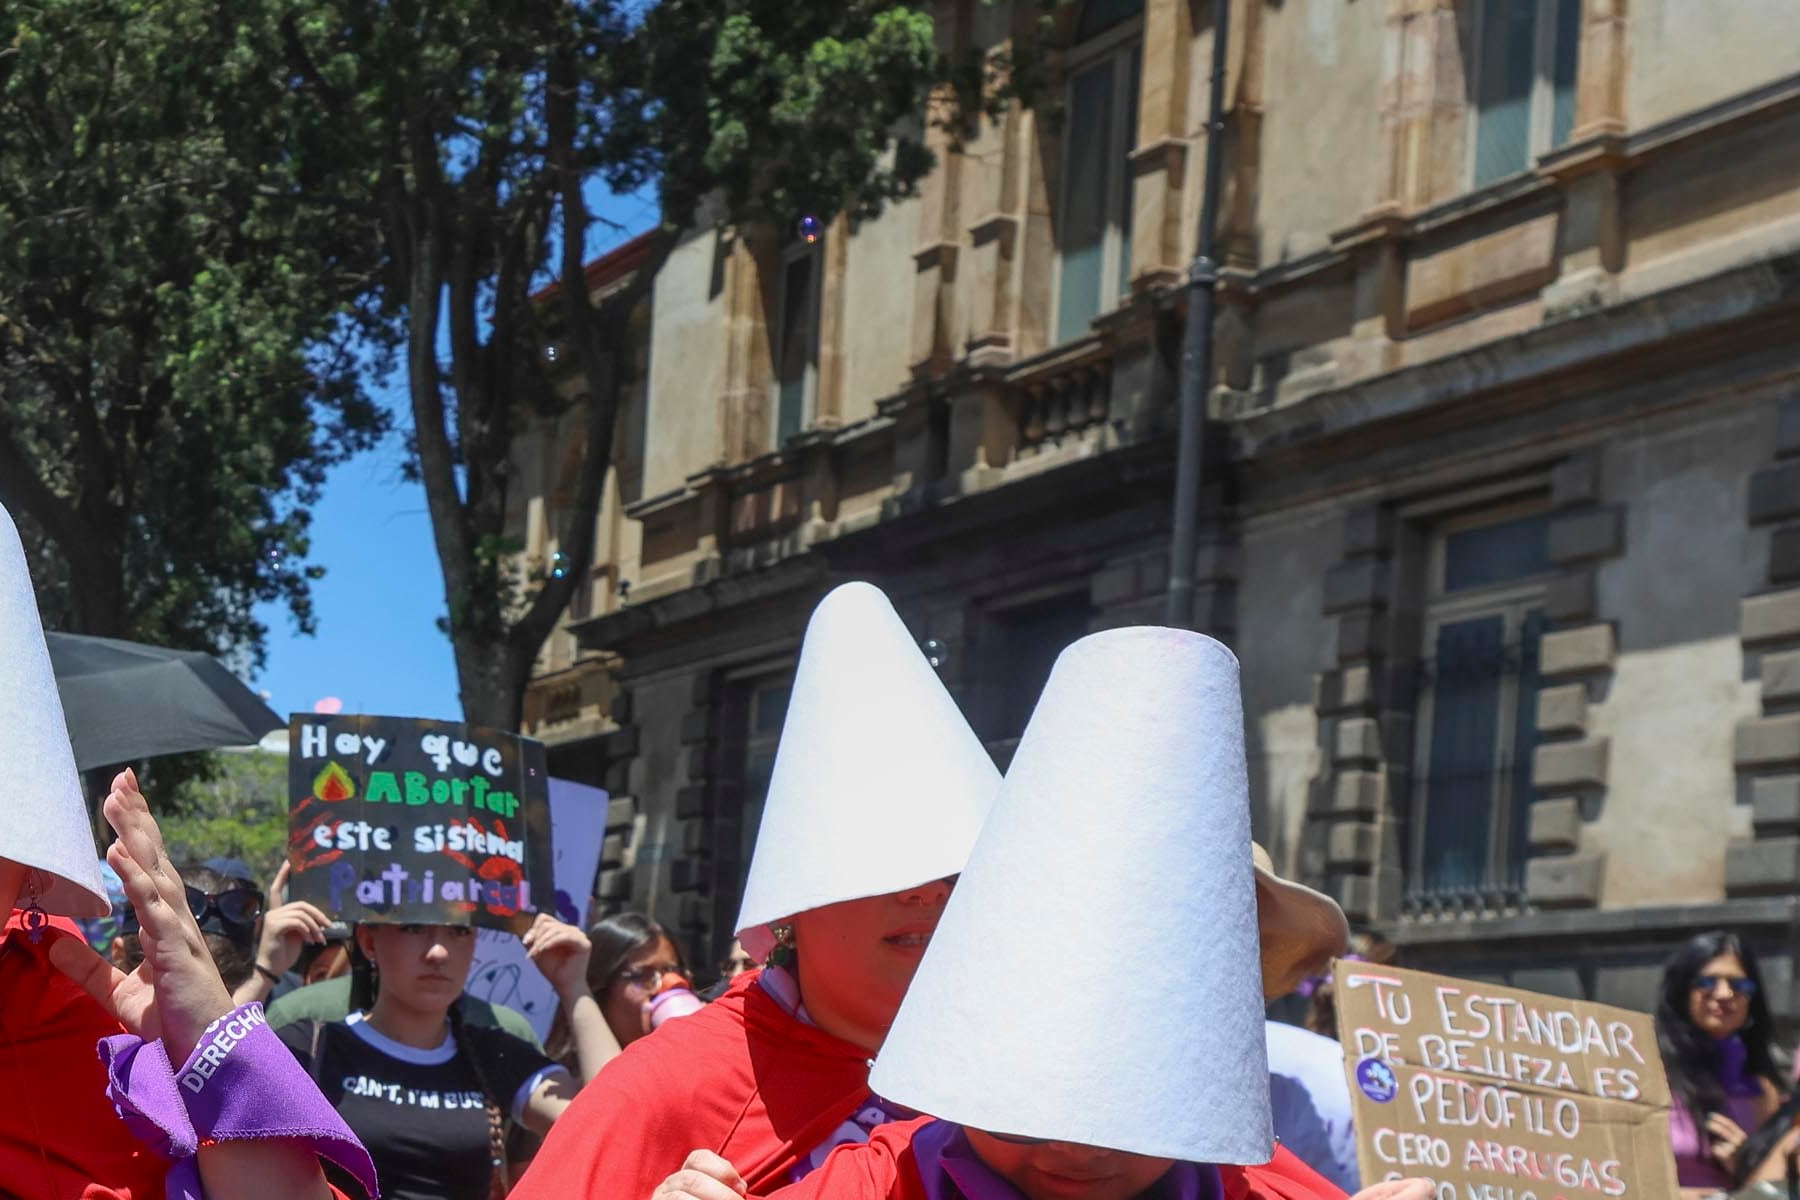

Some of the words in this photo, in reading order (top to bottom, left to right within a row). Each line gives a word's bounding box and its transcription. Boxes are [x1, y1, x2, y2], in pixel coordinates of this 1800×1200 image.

[301, 724, 386, 764] Hay
[421, 733, 503, 776] que
[313, 821, 392, 851] este
[414, 823, 524, 864] sistema
[1435, 985, 1645, 1064] ESTANDAR
[1354, 1028, 1406, 1065] DE
[1417, 1034, 1577, 1090] BELLEZA
[1593, 1068, 1640, 1100] ES
[408, 1089, 440, 1109] I'M
[1373, 1128, 1450, 1167] CERO
[1463, 1139, 1626, 1196] ARRUGAS
